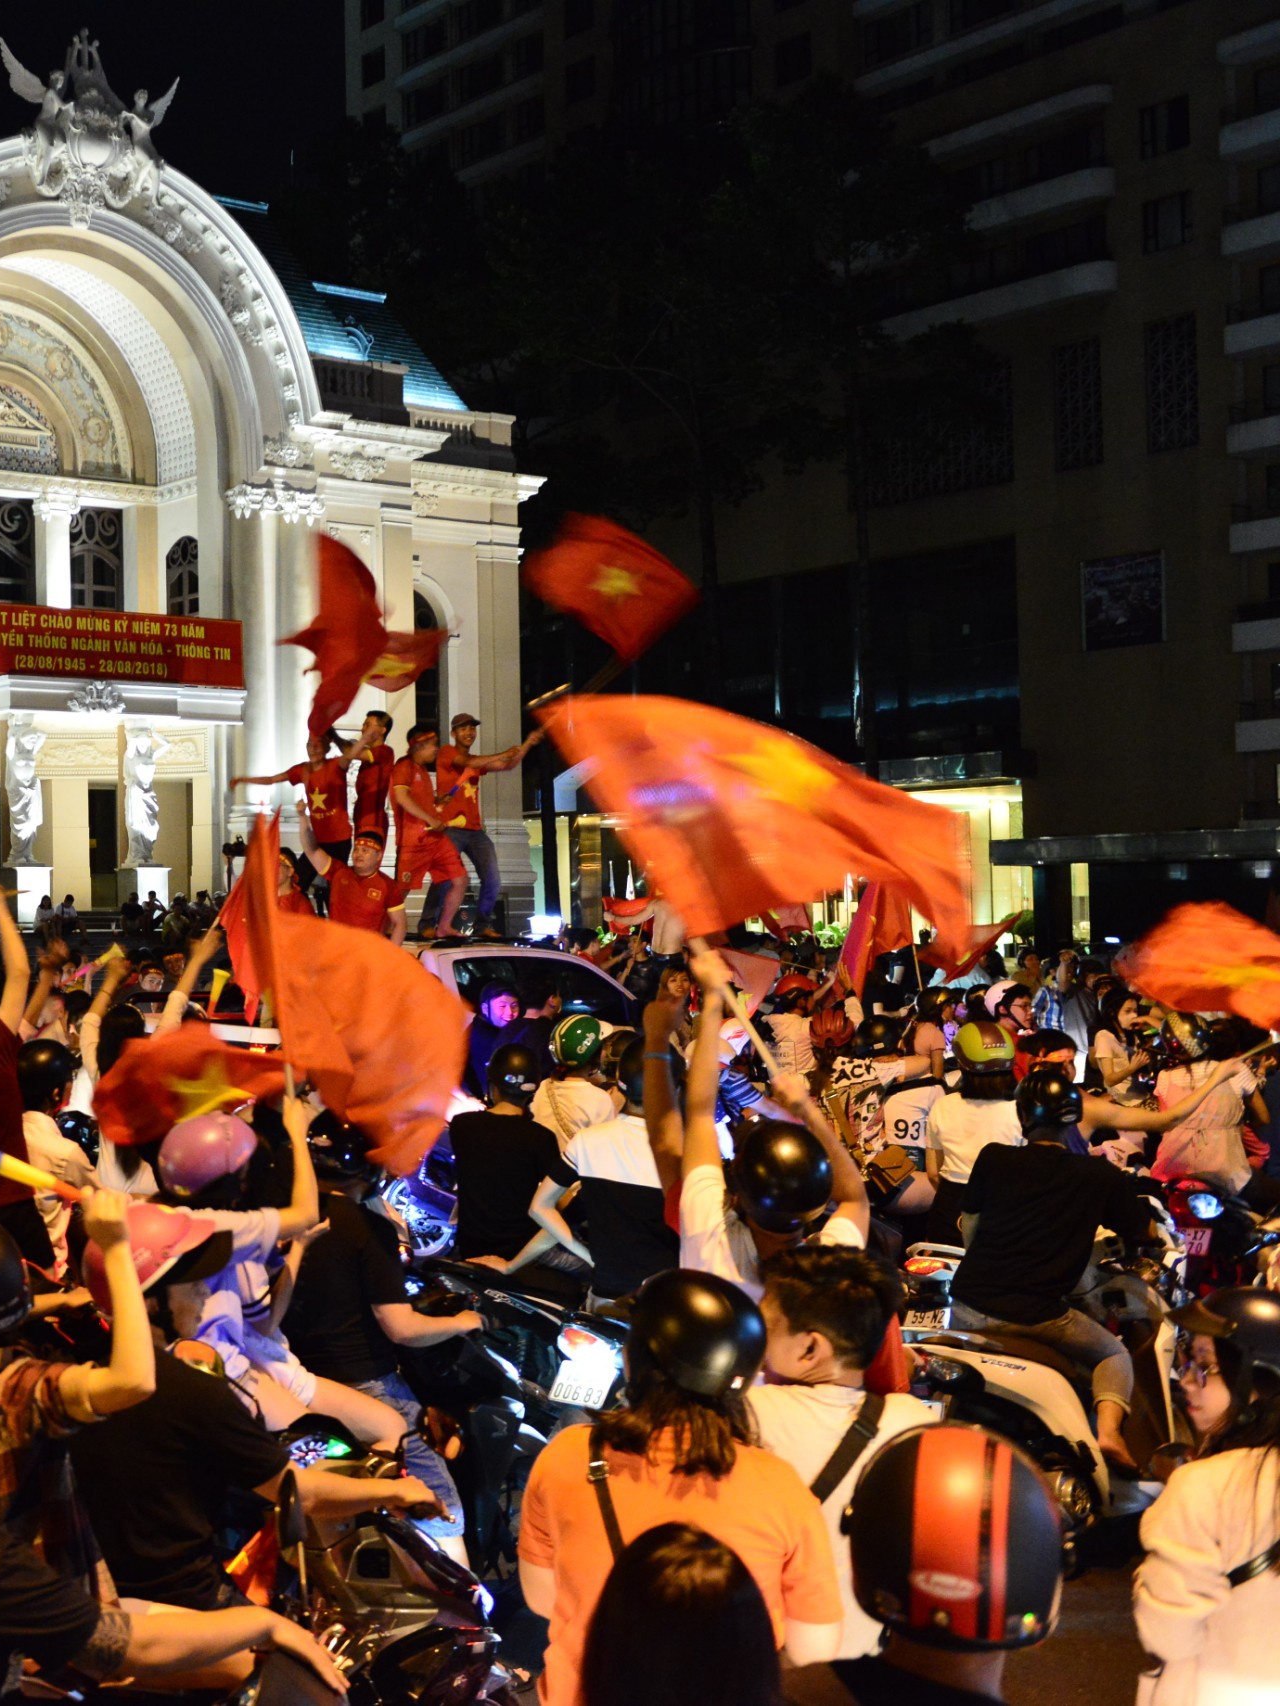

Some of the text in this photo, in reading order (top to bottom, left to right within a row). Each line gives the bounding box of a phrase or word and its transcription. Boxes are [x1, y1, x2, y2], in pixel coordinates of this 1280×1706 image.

[11, 610, 37, 630] LIỆT
[40, 612, 71, 630] CHÀO
[76, 614, 110, 632] MỪNG
[132, 619, 161, 637] NIỆM
[164, 623, 178, 637] 73
[181, 622, 205, 639] NĂM
[28, 631, 67, 649] THỐNG
[71, 635, 110, 652] NGÀNH
[114, 638, 137, 654] VĂN
[140, 639, 164, 656] HÓA
[175, 643, 211, 660] THÔNG
[213, 647, 231, 661] TIN
[15, 654, 86, 671] (28/08/1945
[99, 659, 168, 678] 28/08/2018)
